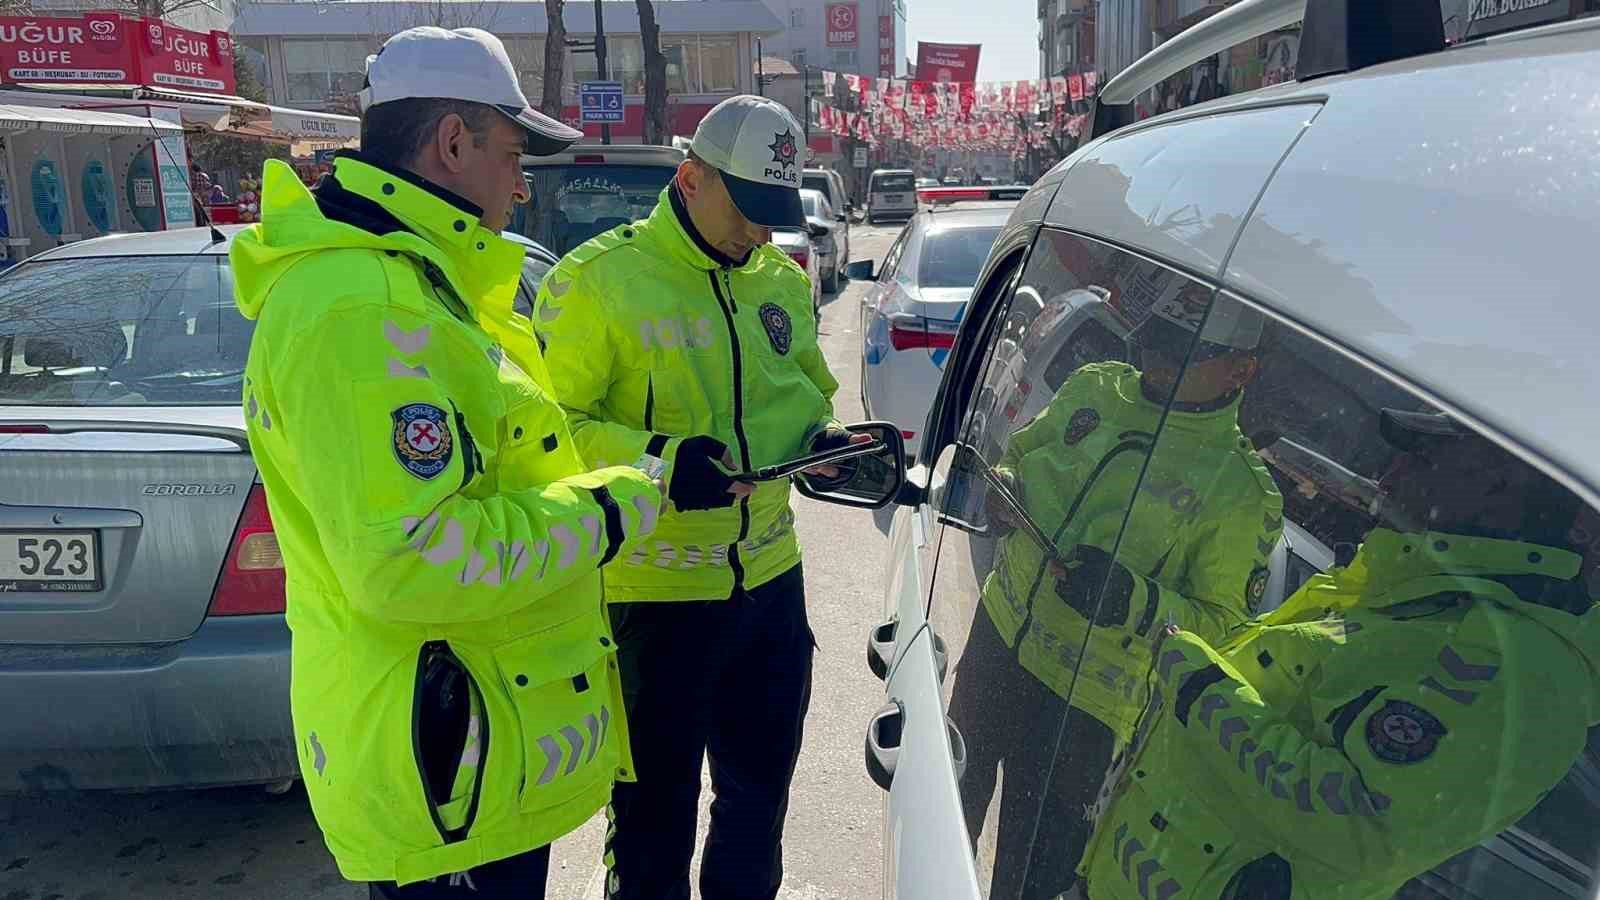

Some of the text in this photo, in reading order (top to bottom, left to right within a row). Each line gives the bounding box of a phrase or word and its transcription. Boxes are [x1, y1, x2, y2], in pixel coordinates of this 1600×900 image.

[0, 21, 84, 44] UĞUR
[830, 31, 856, 42] MHP
[18, 47, 71, 64] BÜFE
[174, 58, 206, 75] BÜFE
[764, 167, 797, 183] POLİS
[142, 483, 236, 497] COROLLA
[18, 538, 88, 576] 523
